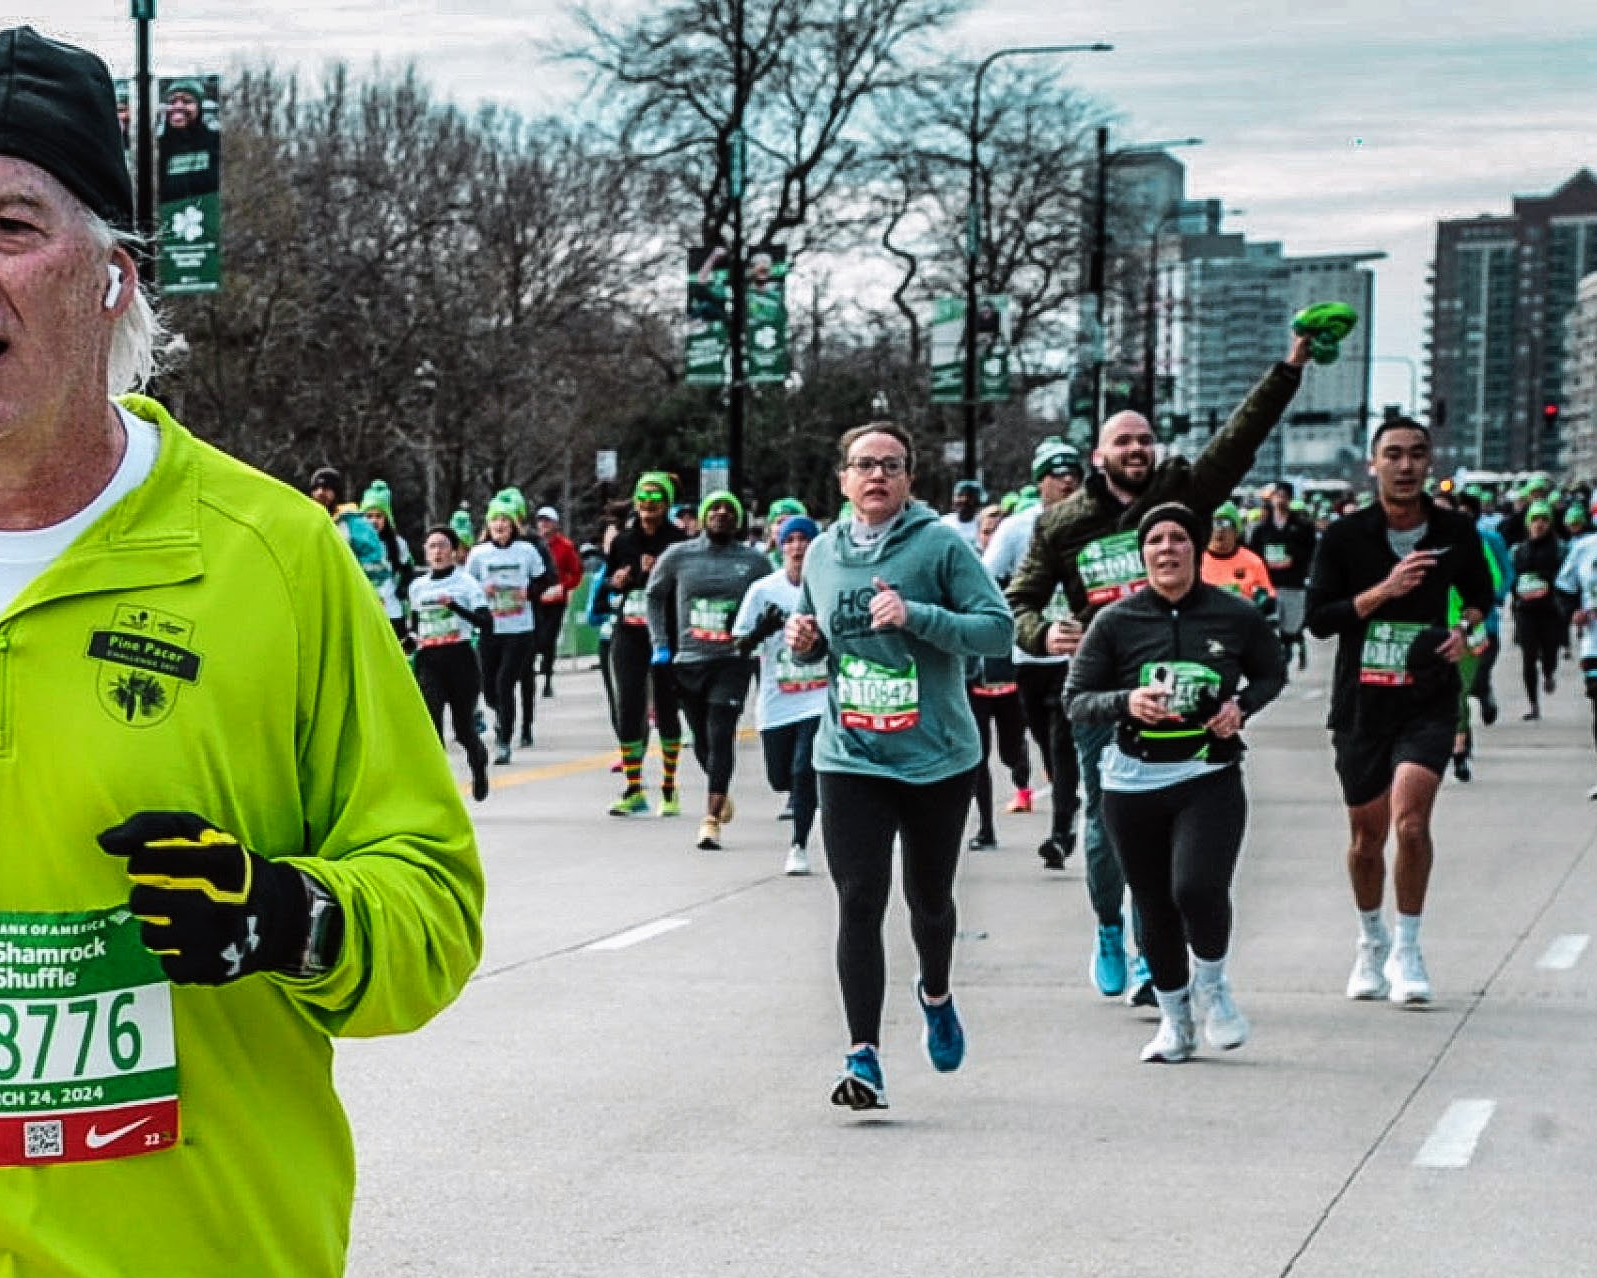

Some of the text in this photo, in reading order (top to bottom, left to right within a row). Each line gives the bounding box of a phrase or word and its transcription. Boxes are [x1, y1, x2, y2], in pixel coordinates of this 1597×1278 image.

[30, 923, 48, 935] OF
[50, 918, 107, 935] AMERICA
[29, 1090, 58, 1106] 24,
[60, 1085, 105, 1103] 2024
